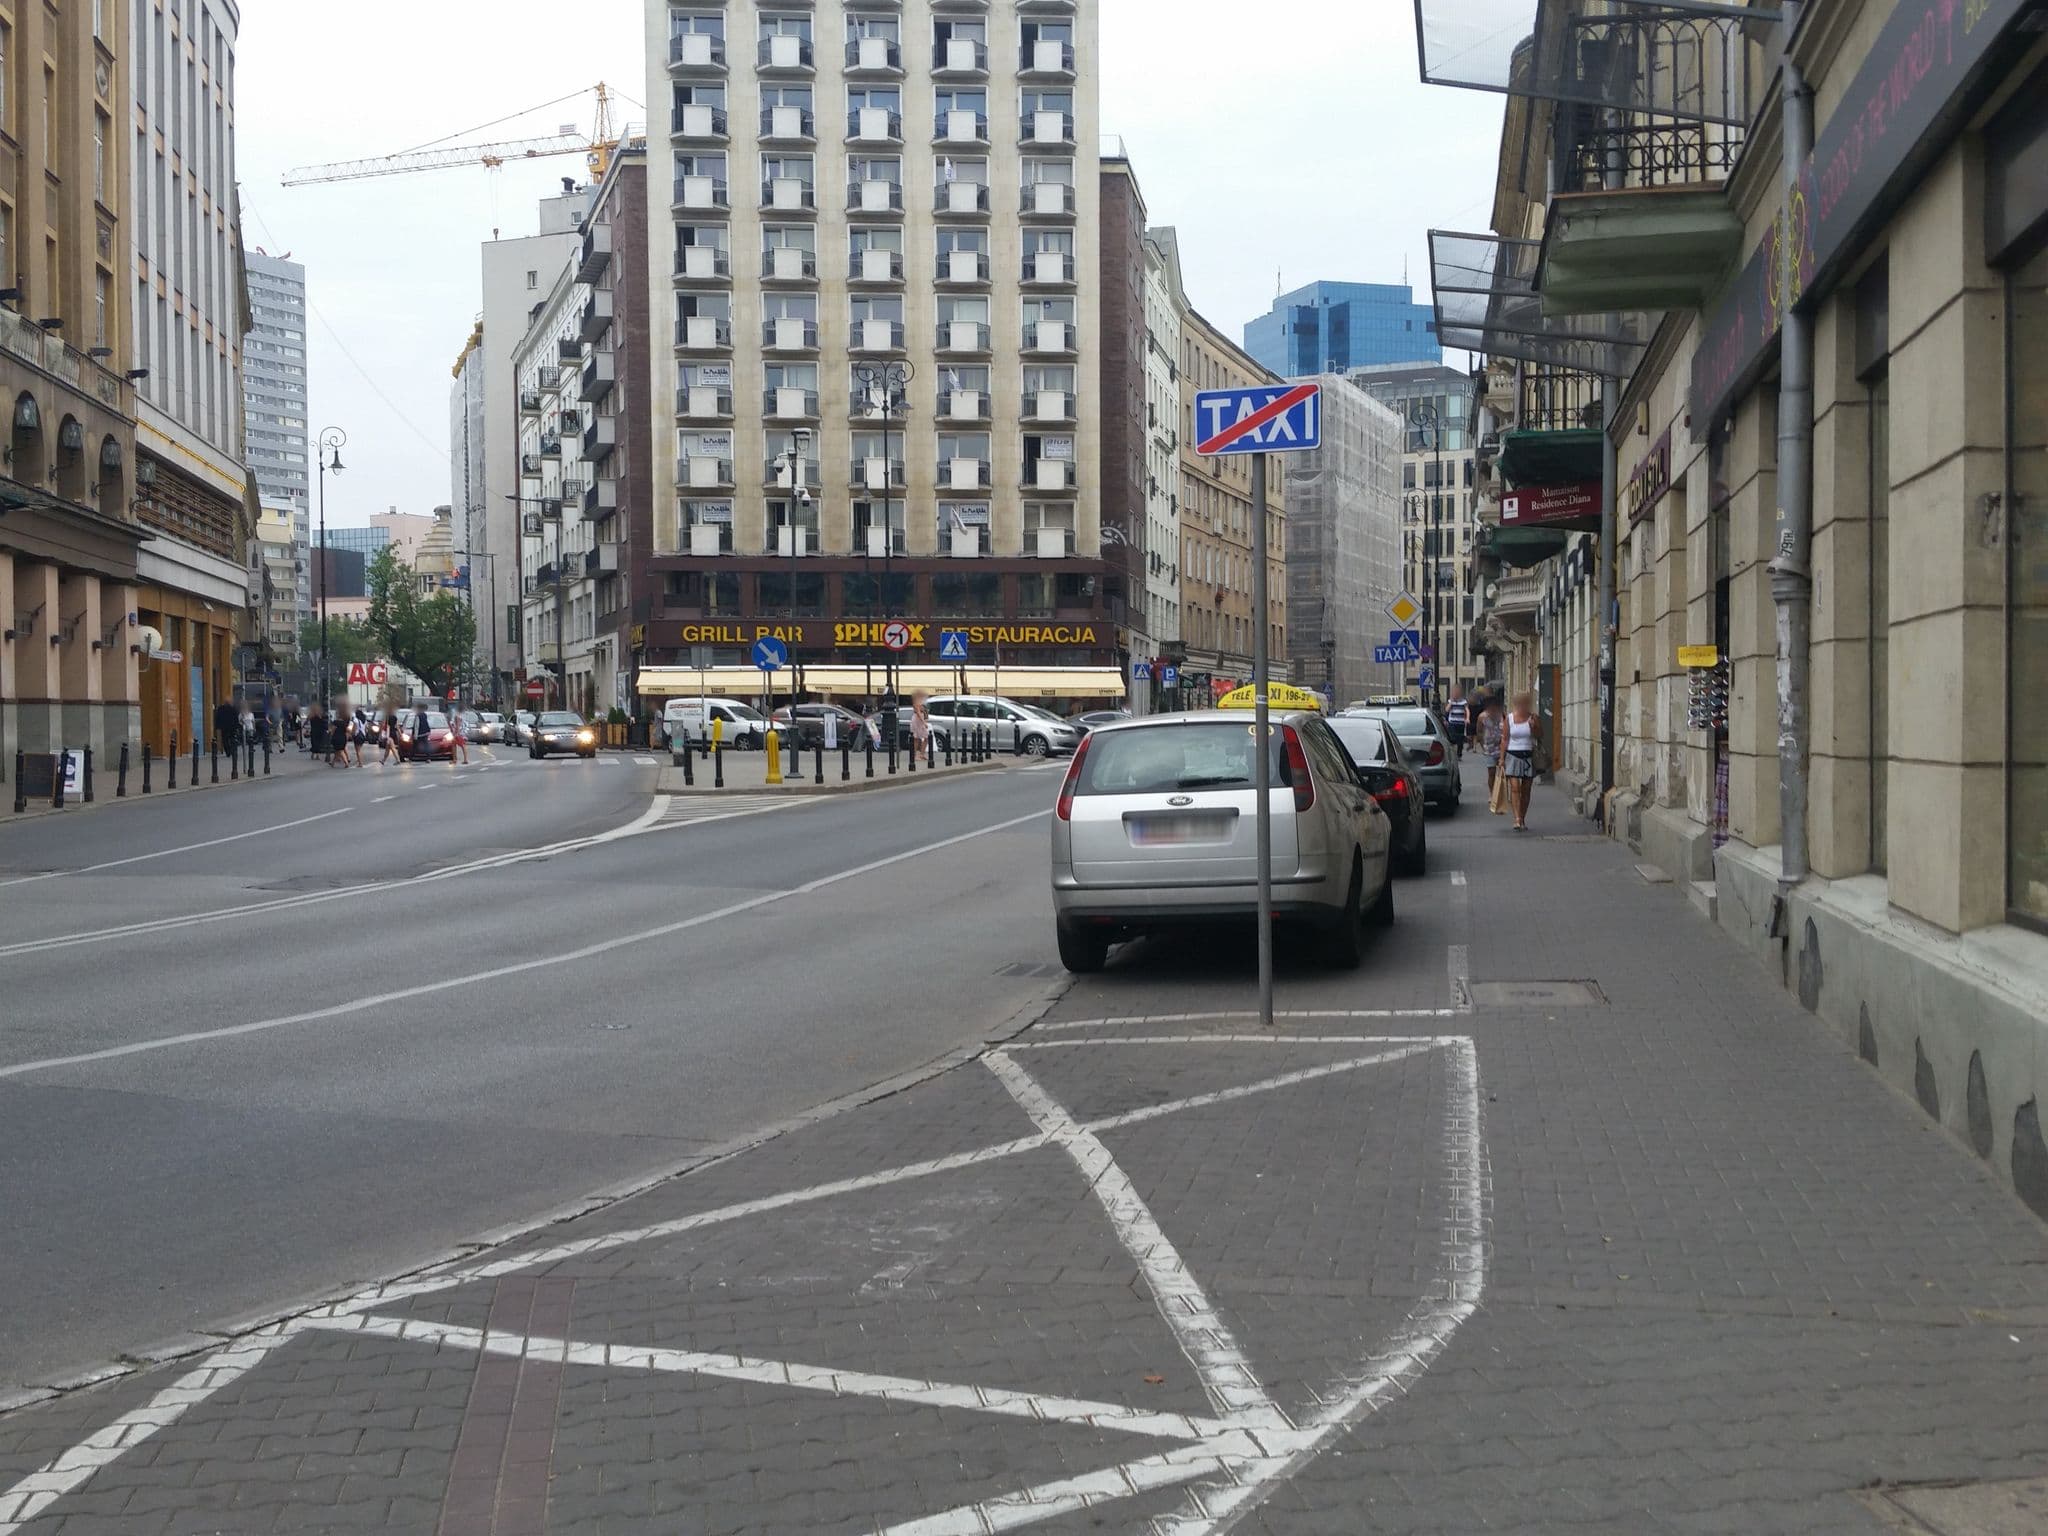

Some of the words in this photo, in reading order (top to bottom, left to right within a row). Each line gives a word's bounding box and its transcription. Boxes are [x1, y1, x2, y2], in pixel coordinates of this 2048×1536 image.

[1201, 394, 1314, 445] TAXI
[1541, 486, 1580, 498] Mamaison
[1531, 499, 1569, 510] Residence
[1569, 494, 1592, 505] Diana
[682, 625, 750, 643] GRILL
[756, 625, 804, 643] BAR
[1376, 647, 1406, 661] TAXI
[1165, 667, 1175, 680] P
[1231, 689, 1251, 701] TELE
